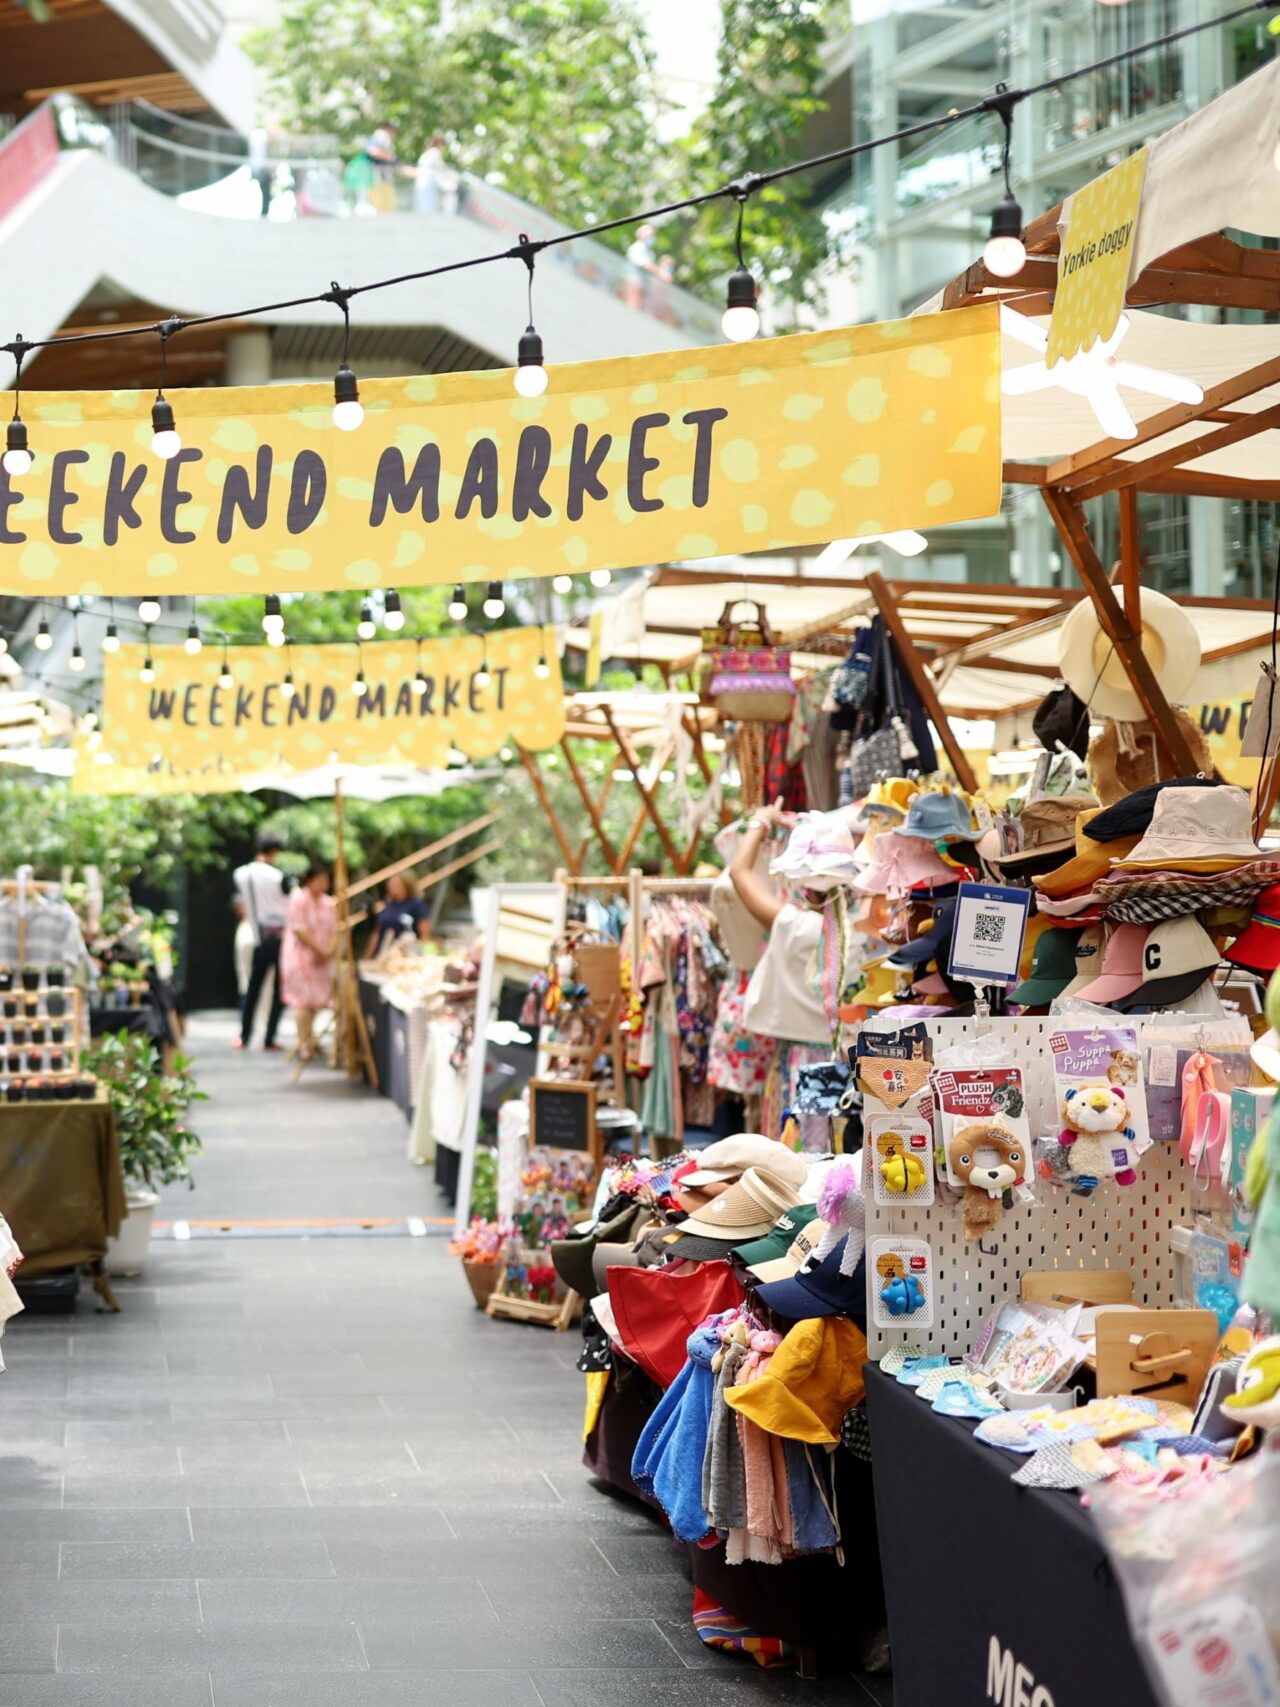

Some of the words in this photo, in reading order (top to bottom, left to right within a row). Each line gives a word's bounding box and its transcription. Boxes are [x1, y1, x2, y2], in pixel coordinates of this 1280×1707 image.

[1062, 242, 1097, 278] Yorkie
[1098, 220, 1134, 256] doggy
[368, 407, 729, 528] MARKET
[148, 682, 338, 728] WEEKEND
[355, 665, 511, 720] MARKET
[1144, 943, 1162, 971] C
[1077, 1044, 1112, 1059] Suppa
[1064, 1056, 1100, 1072] Puppa
[951, 1094, 992, 1106] Friendz
[961, 1084, 992, 1094] PLUSH
